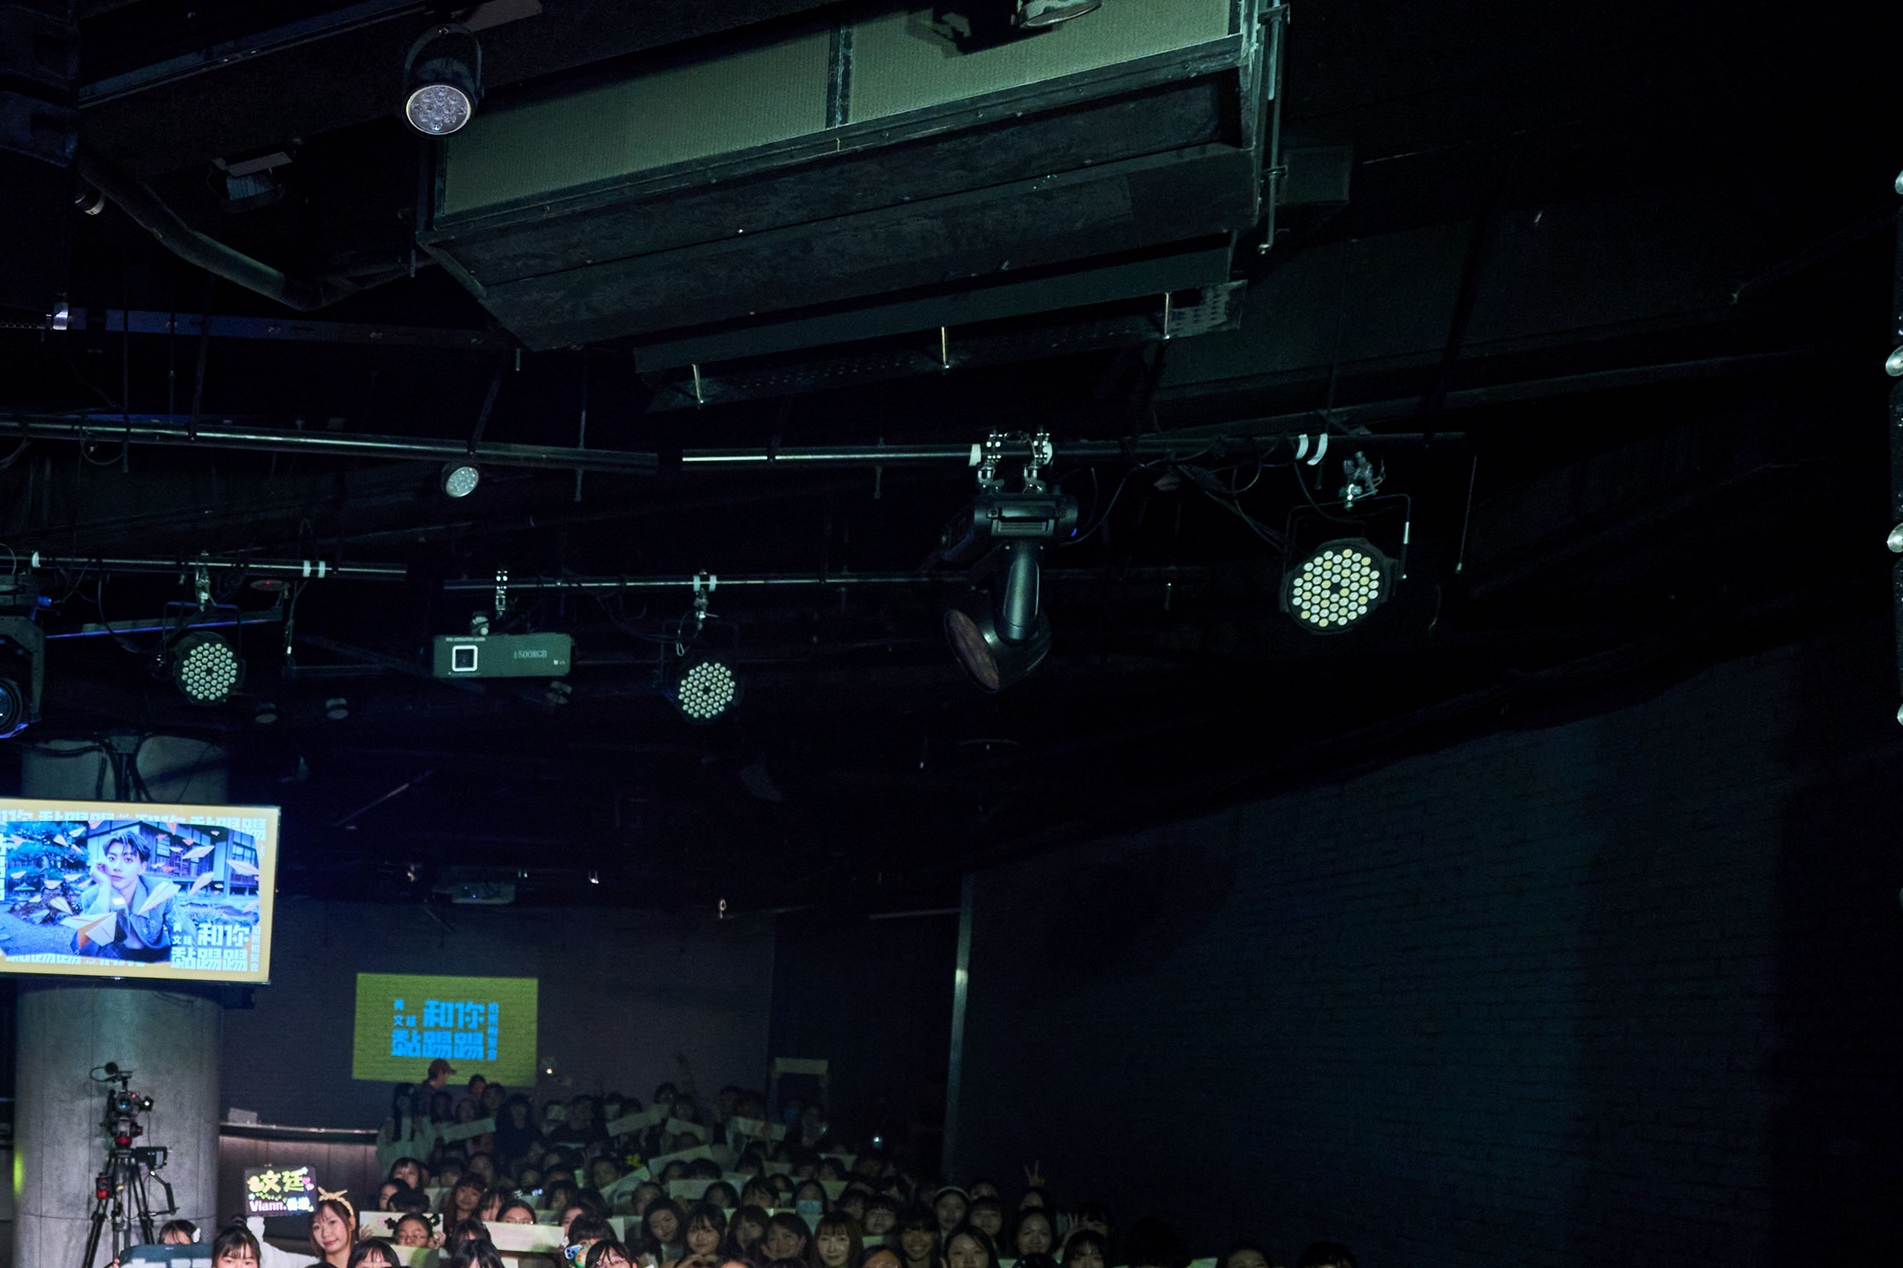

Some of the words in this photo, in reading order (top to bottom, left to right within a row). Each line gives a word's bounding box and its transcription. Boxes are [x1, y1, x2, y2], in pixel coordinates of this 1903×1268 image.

[197, 923, 250, 947] 和你
[423, 999, 485, 1029] 和你
[260, 1169, 305, 1193] 文廷
